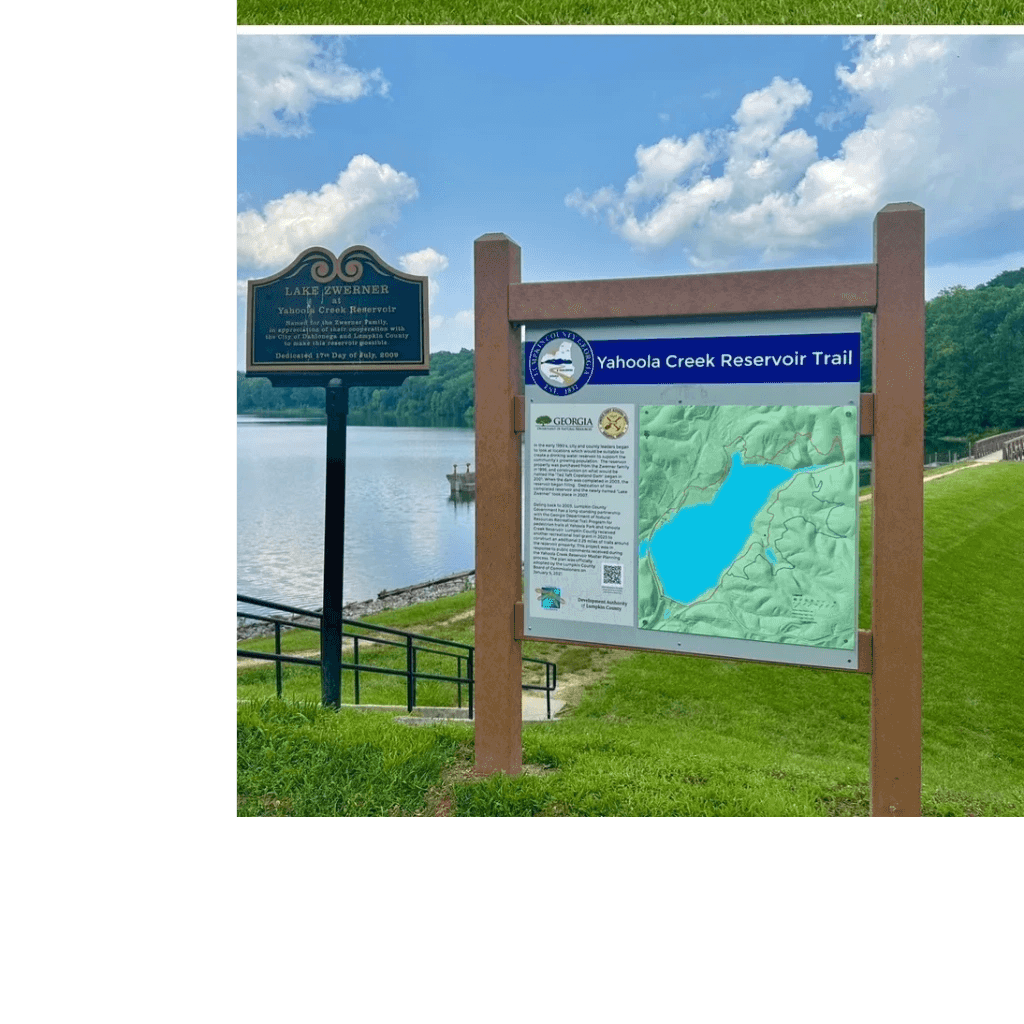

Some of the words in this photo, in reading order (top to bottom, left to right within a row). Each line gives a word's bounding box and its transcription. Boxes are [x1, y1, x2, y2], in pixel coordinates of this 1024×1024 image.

[285, 287, 319, 296] LAKE
[324, 285, 390, 295] ZWERNER
[350, 306, 396, 314] Reservoir
[598, 354, 660, 368] Yahoola
[666, 354, 714, 368] Creek
[722, 351, 806, 367] Reservoir
[812, 350, 852, 366] Trail
[553, 418, 592, 426] GEORGIA
